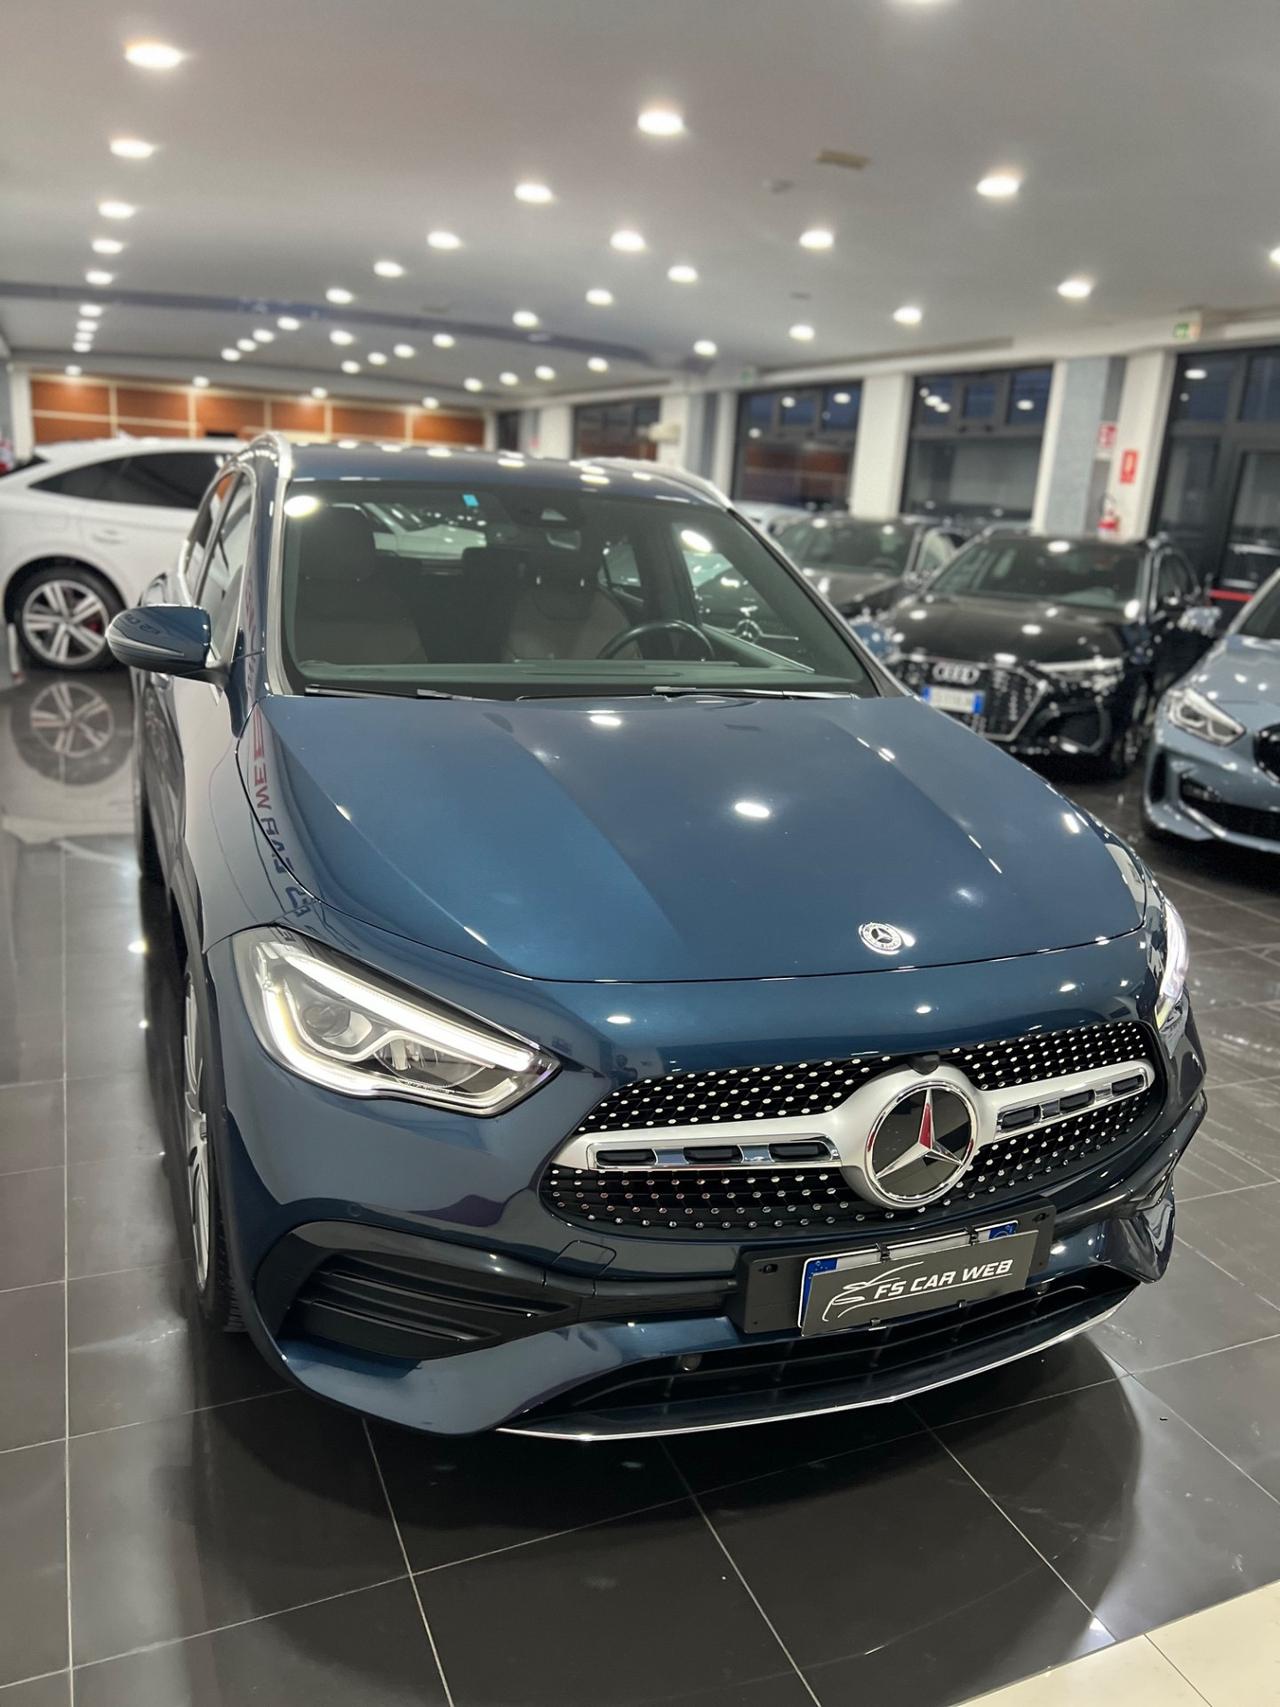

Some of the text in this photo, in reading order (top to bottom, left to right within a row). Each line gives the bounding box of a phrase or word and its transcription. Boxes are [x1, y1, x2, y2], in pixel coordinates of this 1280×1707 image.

[873, 1259, 1014, 1299] FS CAR WEB
